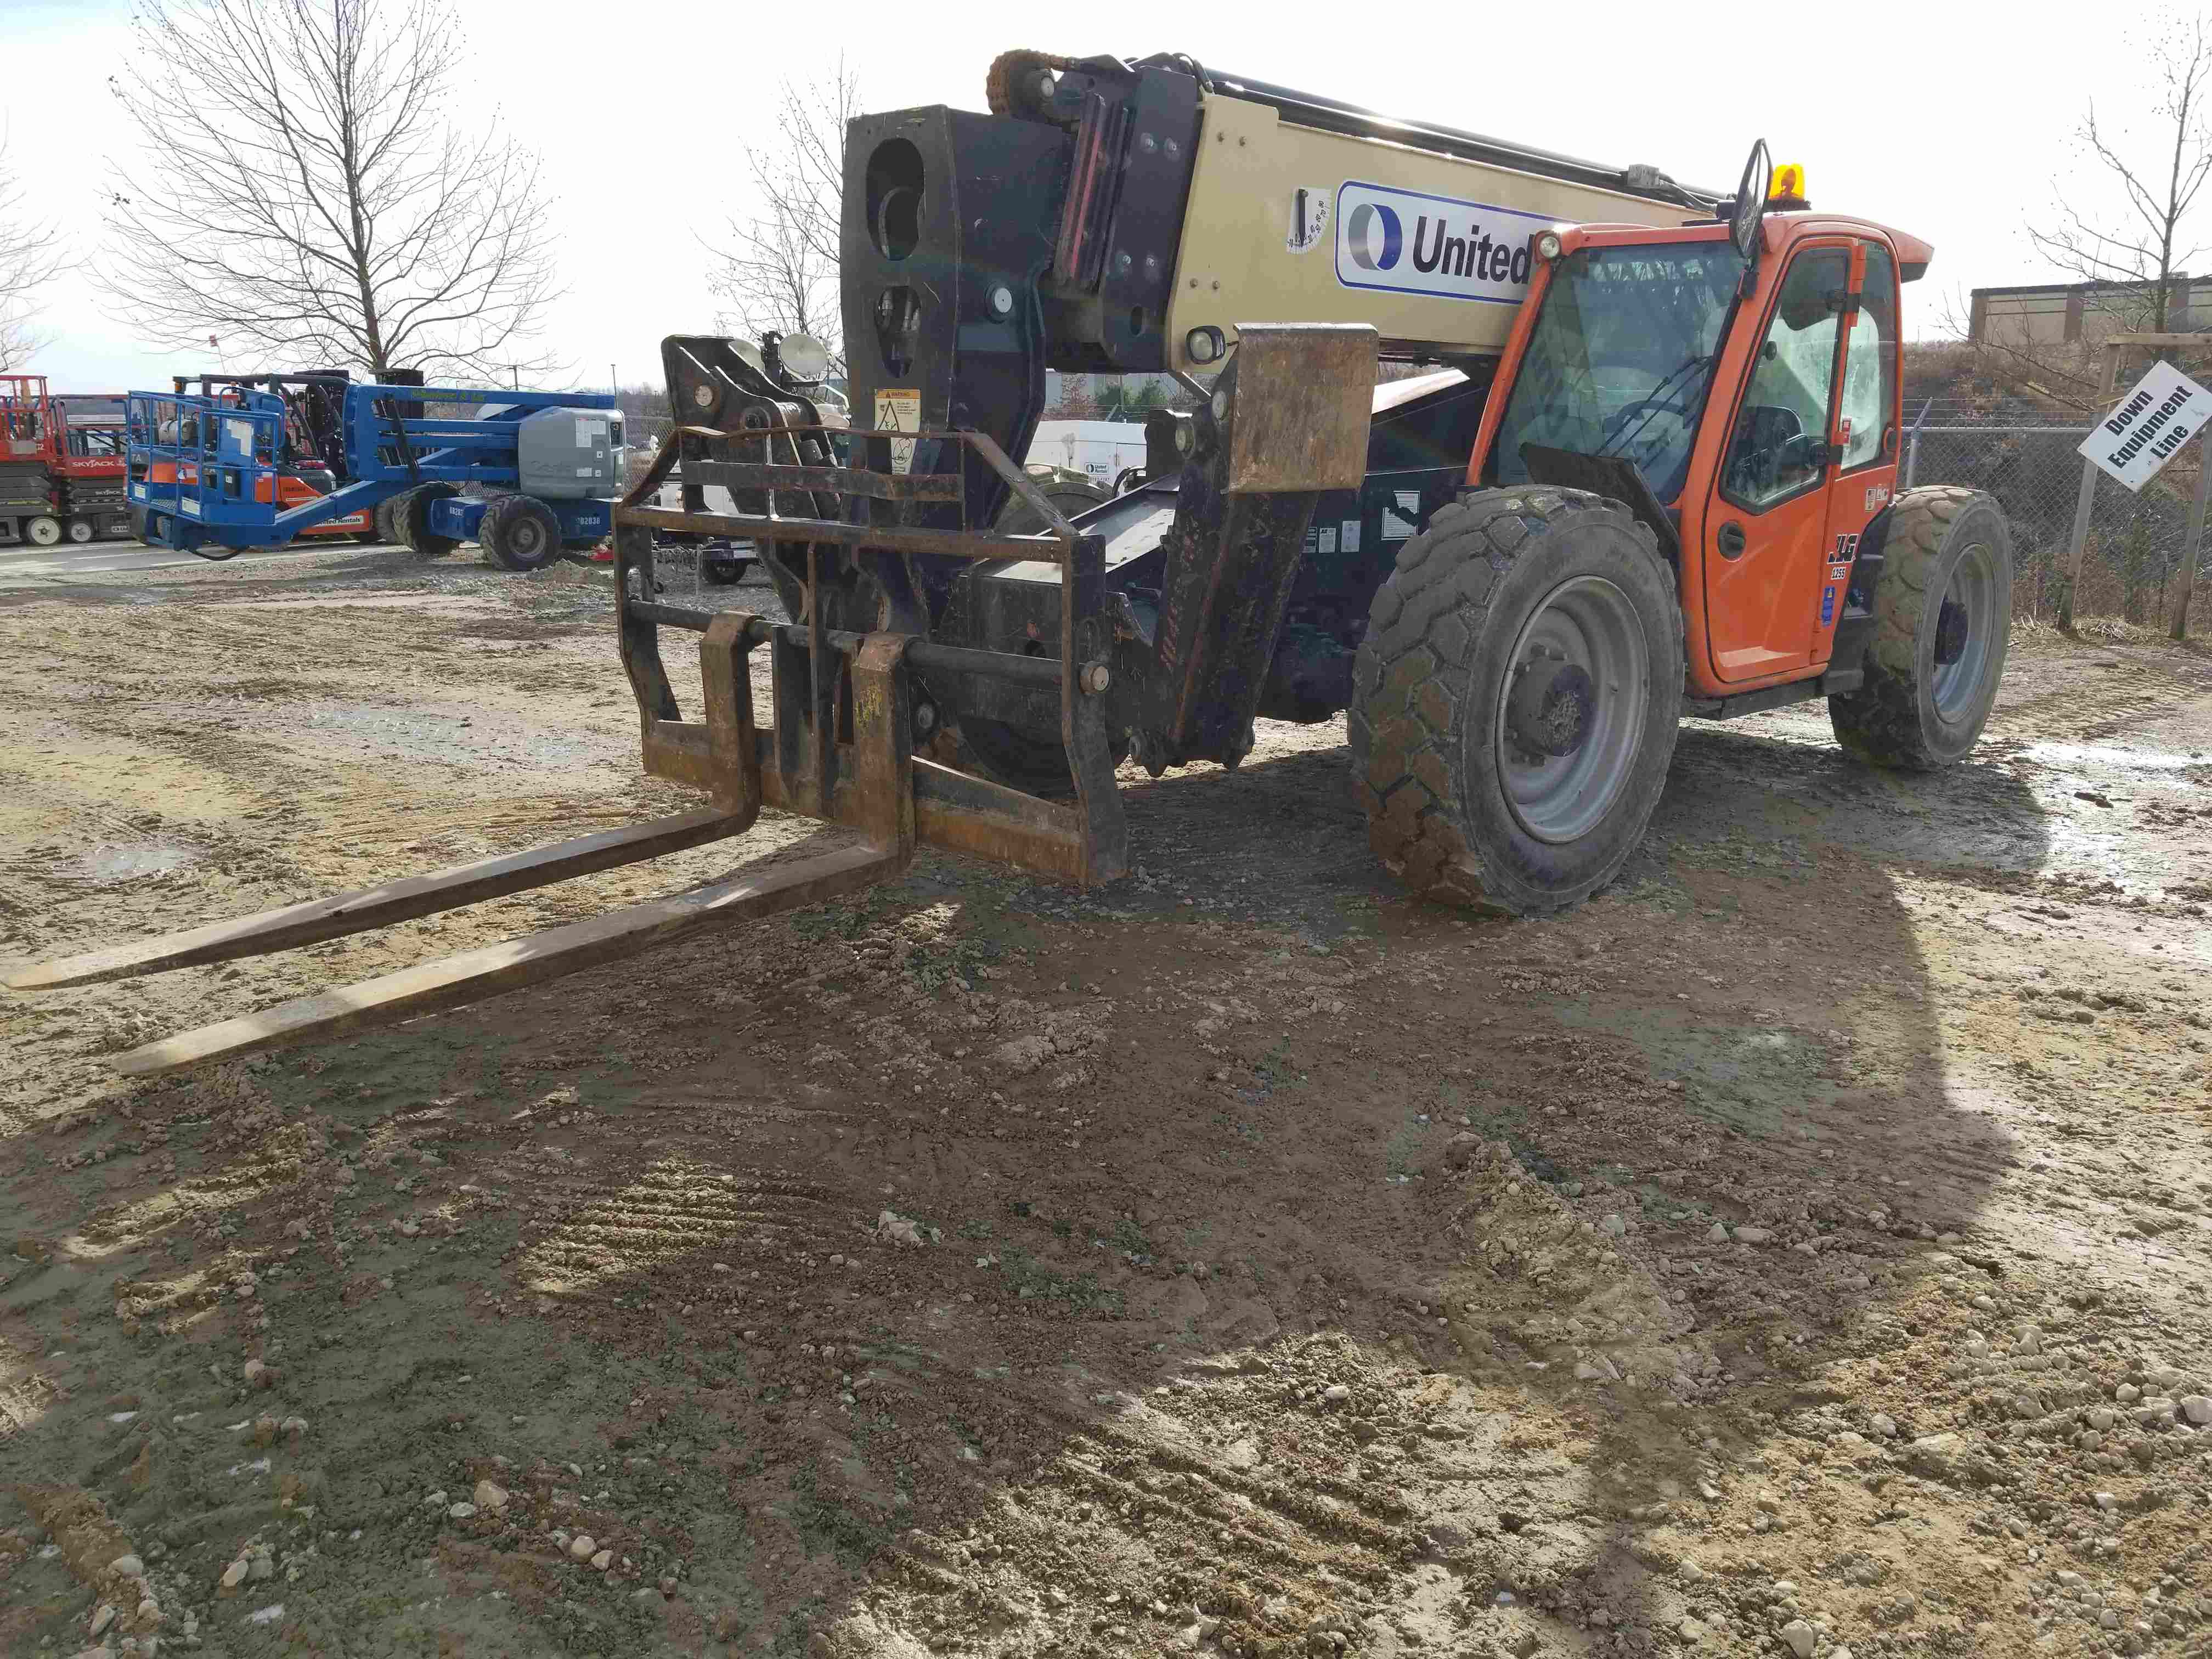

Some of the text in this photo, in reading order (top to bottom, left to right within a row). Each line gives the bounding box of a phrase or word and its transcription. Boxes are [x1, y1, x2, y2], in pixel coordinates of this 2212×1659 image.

[1413, 216, 1536, 284] United
[2104, 391, 2154, 436] Down
[2107, 385, 2193, 469] Equipment
[2149, 426, 2188, 460] Line
[72, 459, 114, 467] SKYJACK
[1832, 567, 1846, 579] 1255
